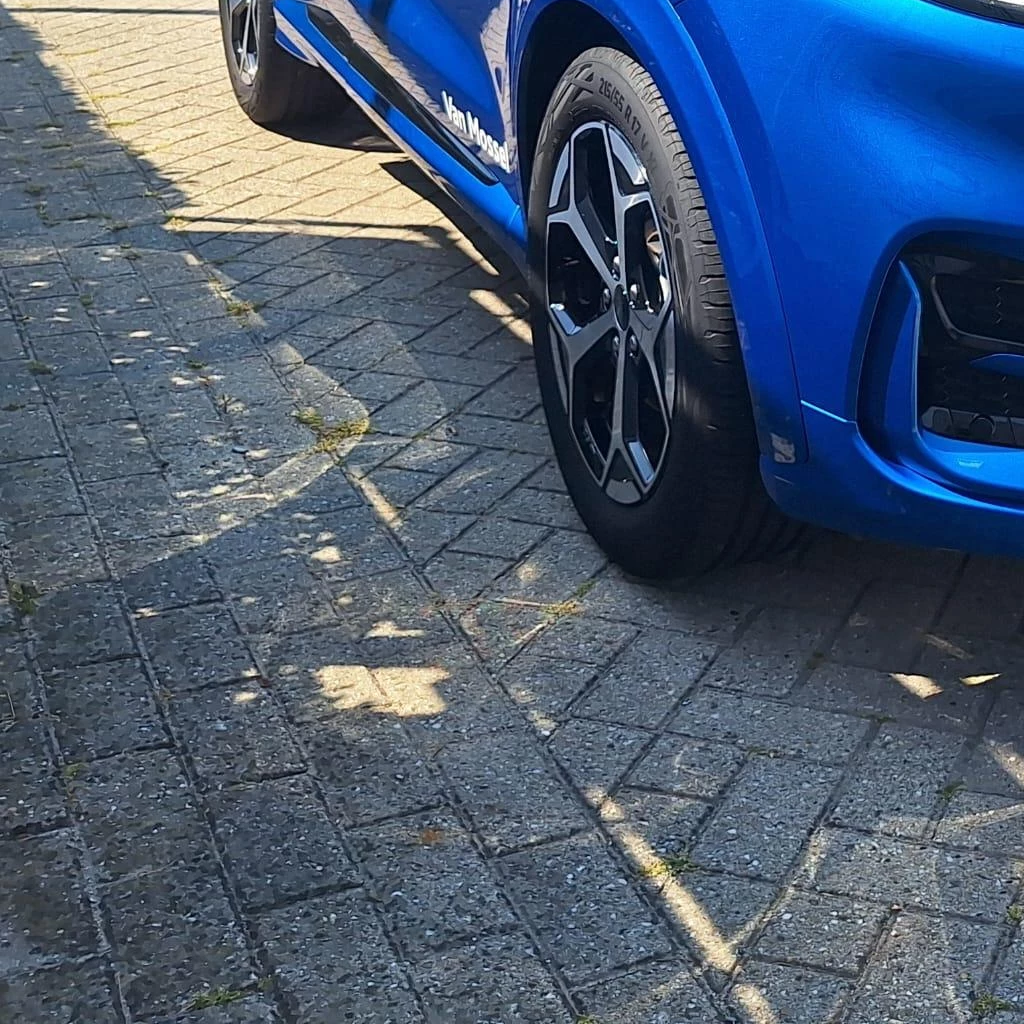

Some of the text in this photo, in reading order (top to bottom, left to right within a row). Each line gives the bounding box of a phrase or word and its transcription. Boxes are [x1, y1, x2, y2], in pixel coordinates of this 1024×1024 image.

[441, 89, 511, 174] Van Mossel
[598, 77, 625, 113] 215/55
[624, 104, 632, 124] R
[630, 115, 642, 136] 17
